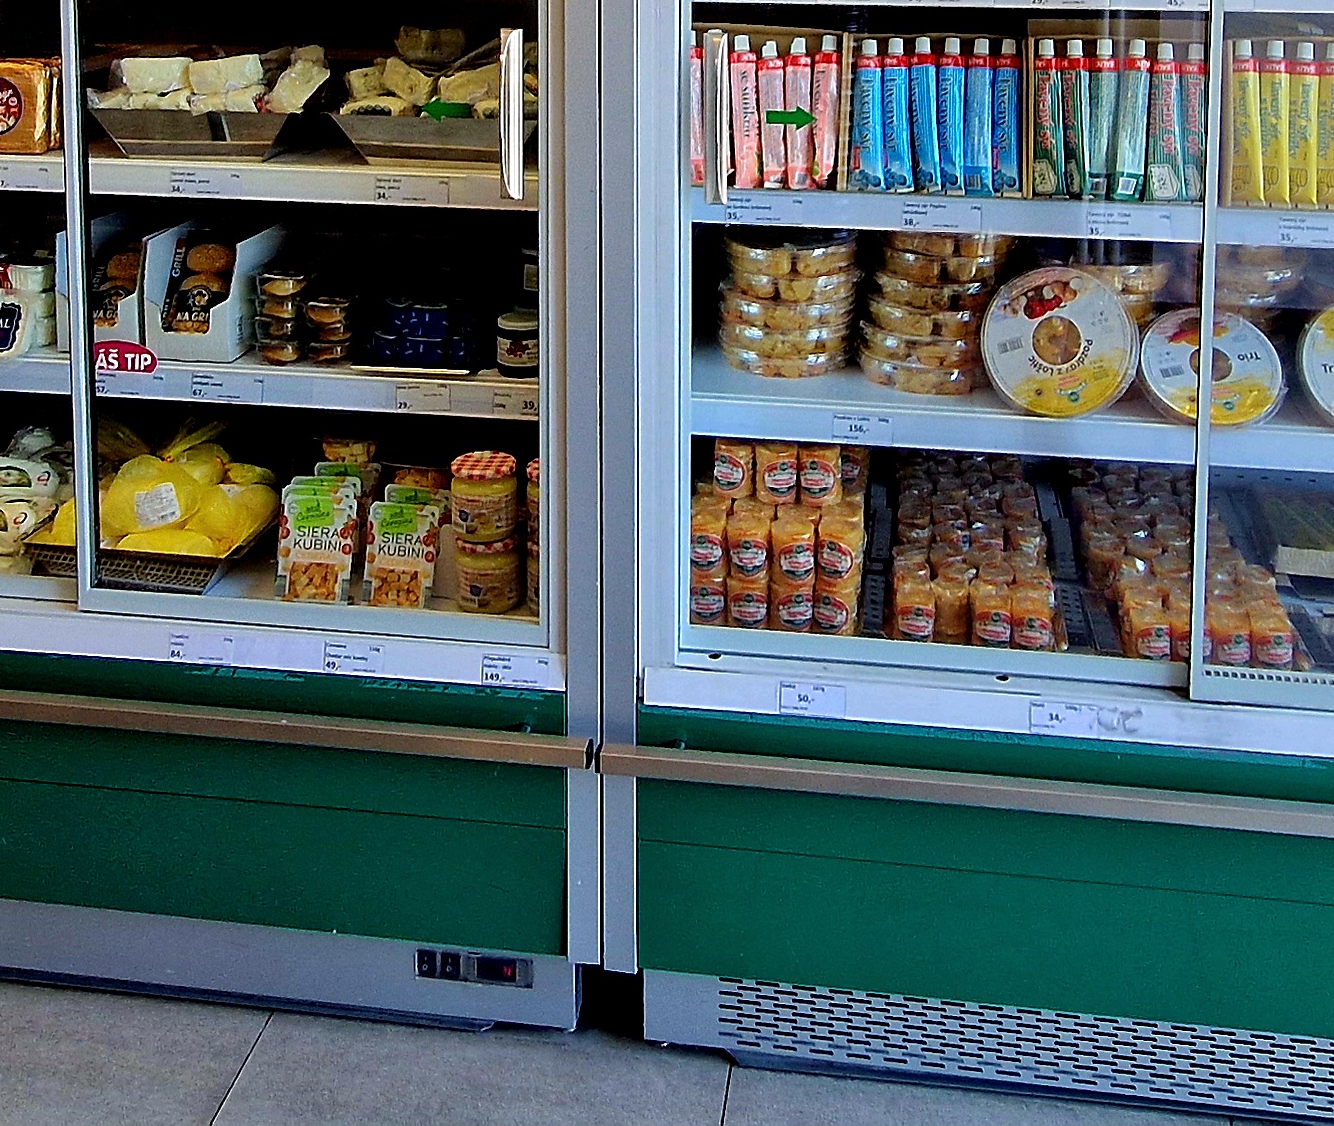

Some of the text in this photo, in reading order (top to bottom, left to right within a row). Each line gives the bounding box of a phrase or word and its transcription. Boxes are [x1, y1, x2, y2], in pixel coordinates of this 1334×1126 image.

[903, 218, 920, 227] 38,-
[171, 246, 186, 278] GRILL
[95, 348, 152, 370] ÁŠ TIP
[1237, 350, 1261, 363] Trio
[522, 400, 537, 412] 39,
[297, 525, 339, 538] SIERA
[381, 531, 423, 546] SIERA
[483, 672, 505, 683] 149,-
[797, 694, 815, 705] 50,-
